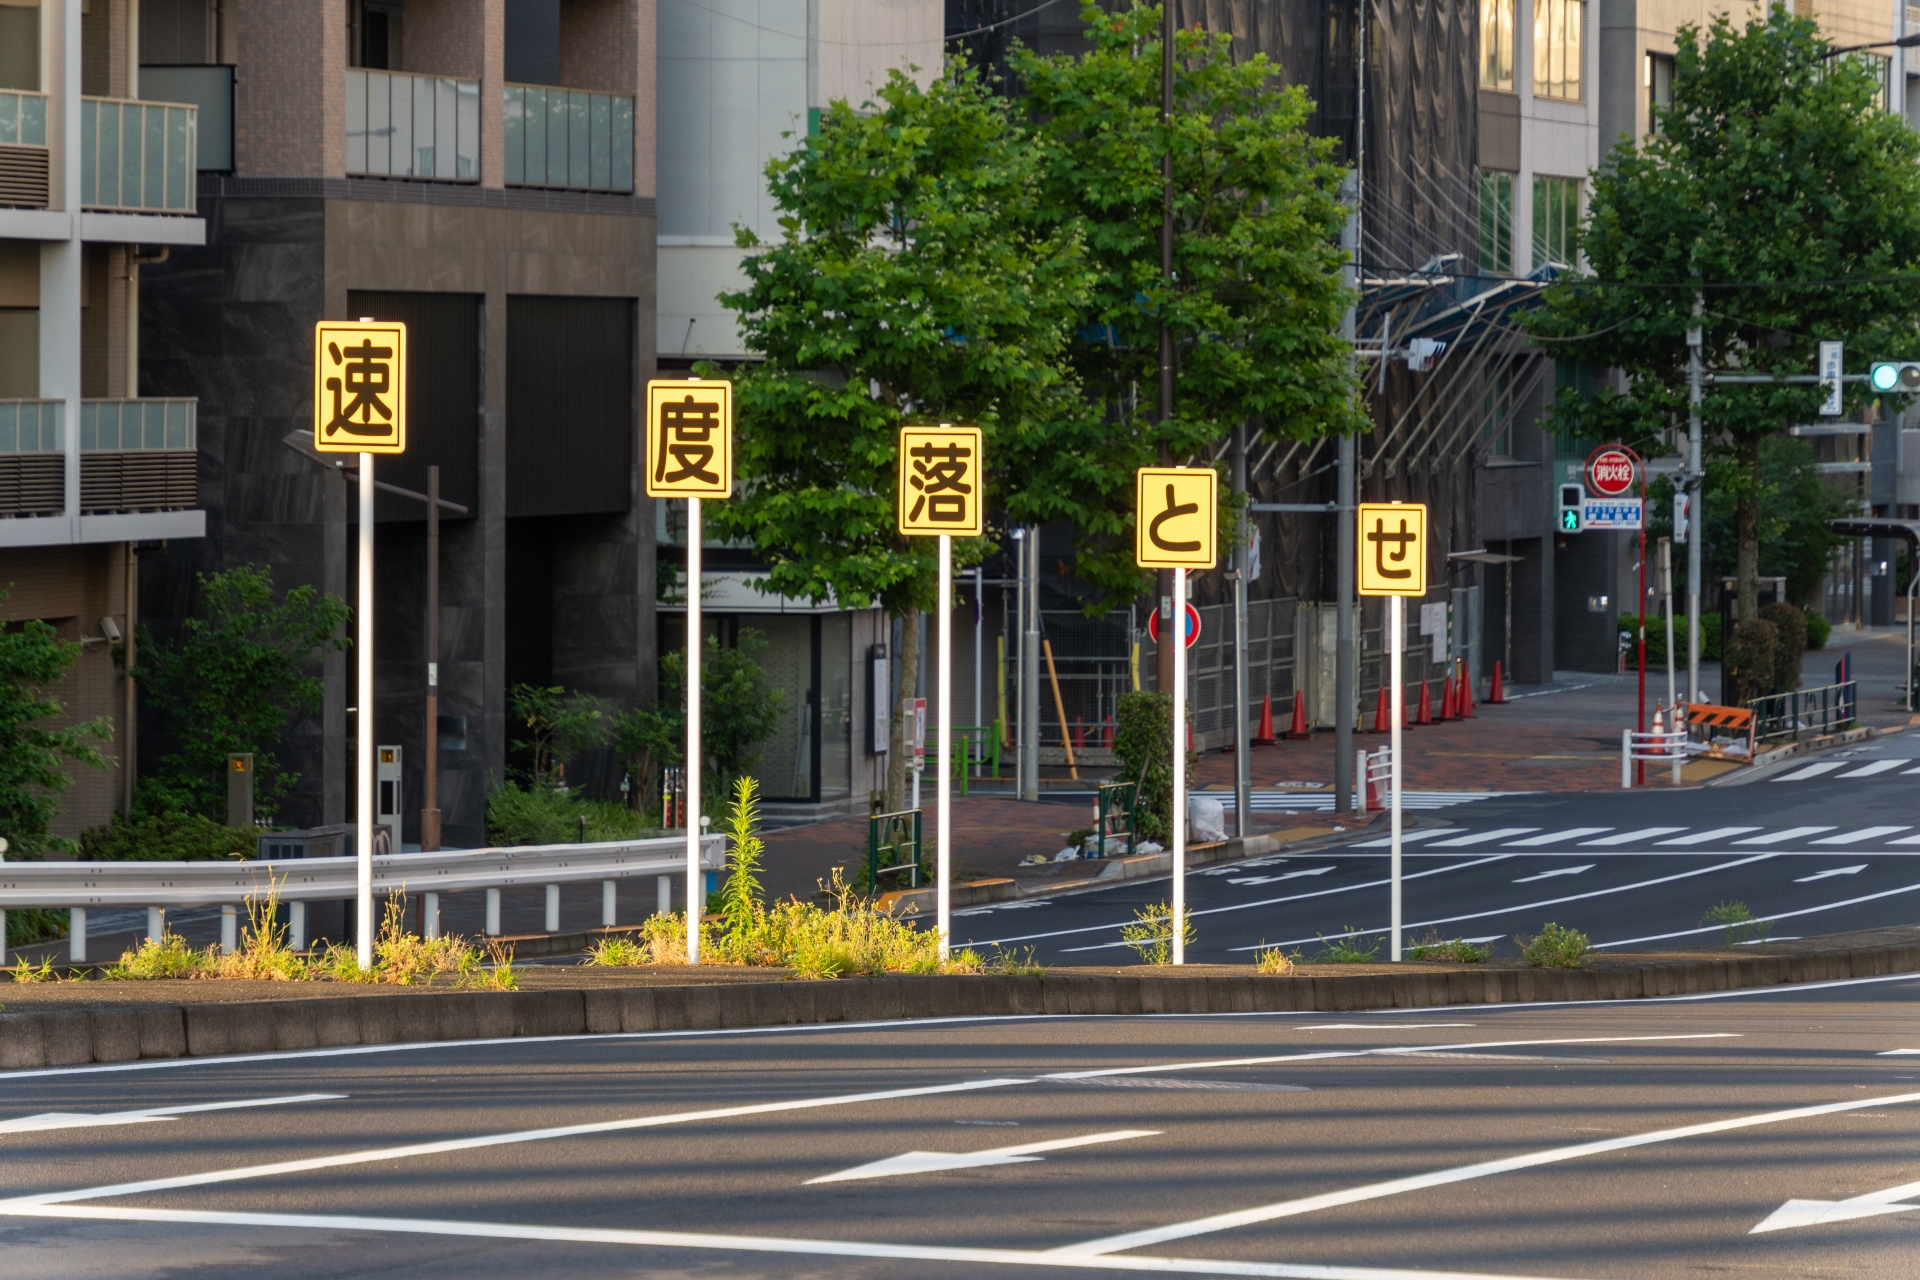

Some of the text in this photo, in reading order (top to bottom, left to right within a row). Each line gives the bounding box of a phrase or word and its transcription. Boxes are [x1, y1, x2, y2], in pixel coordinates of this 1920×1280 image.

[326, 339, 393, 437] 速
[656, 395, 720, 485] 度
[1597, 464, 1630, 481] 消火栓
[909, 442, 972, 523] 落
[1149, 484, 1201, 552] と
[1367, 518, 1416, 579] せ
